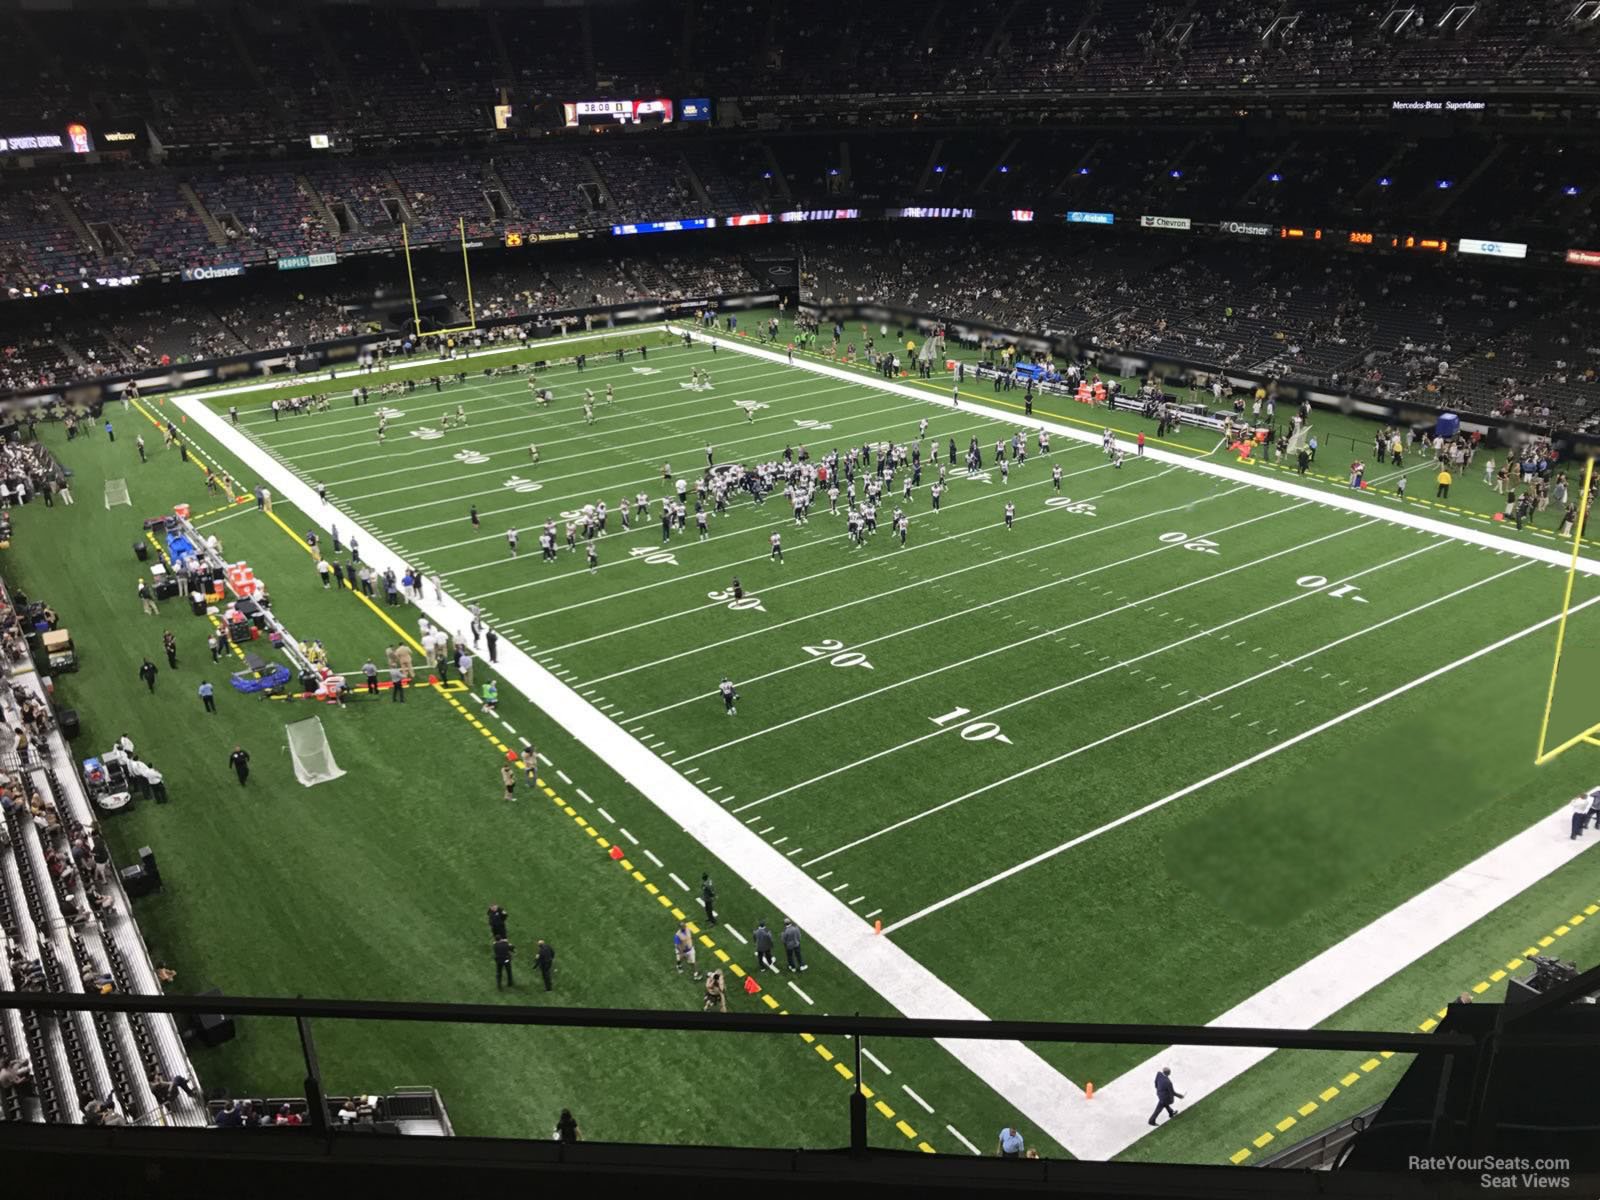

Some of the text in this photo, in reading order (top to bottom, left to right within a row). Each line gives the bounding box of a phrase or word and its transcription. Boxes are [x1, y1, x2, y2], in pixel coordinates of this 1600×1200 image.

[1392, 101, 1486, 111] Mercedes-Benz Superdome
[8, 136, 38, 150] SPORTS
[104, 132, 137, 142] verizon
[1156, 217, 1187, 228] Chevron
[1229, 222, 1269, 236] Ochsner
[539, 232, 579, 241] Mercedes-Benz
[279, 253, 336, 271] PEOPLES HEALTH
[194, 266, 241, 281] Ochsner
[1158, 532, 1221, 552] 20
[628, 546, 676, 565] 40
[1296, 575, 1362, 598] 10
[801, 639, 867, 668] 20
[928, 706, 1001, 742] 10
